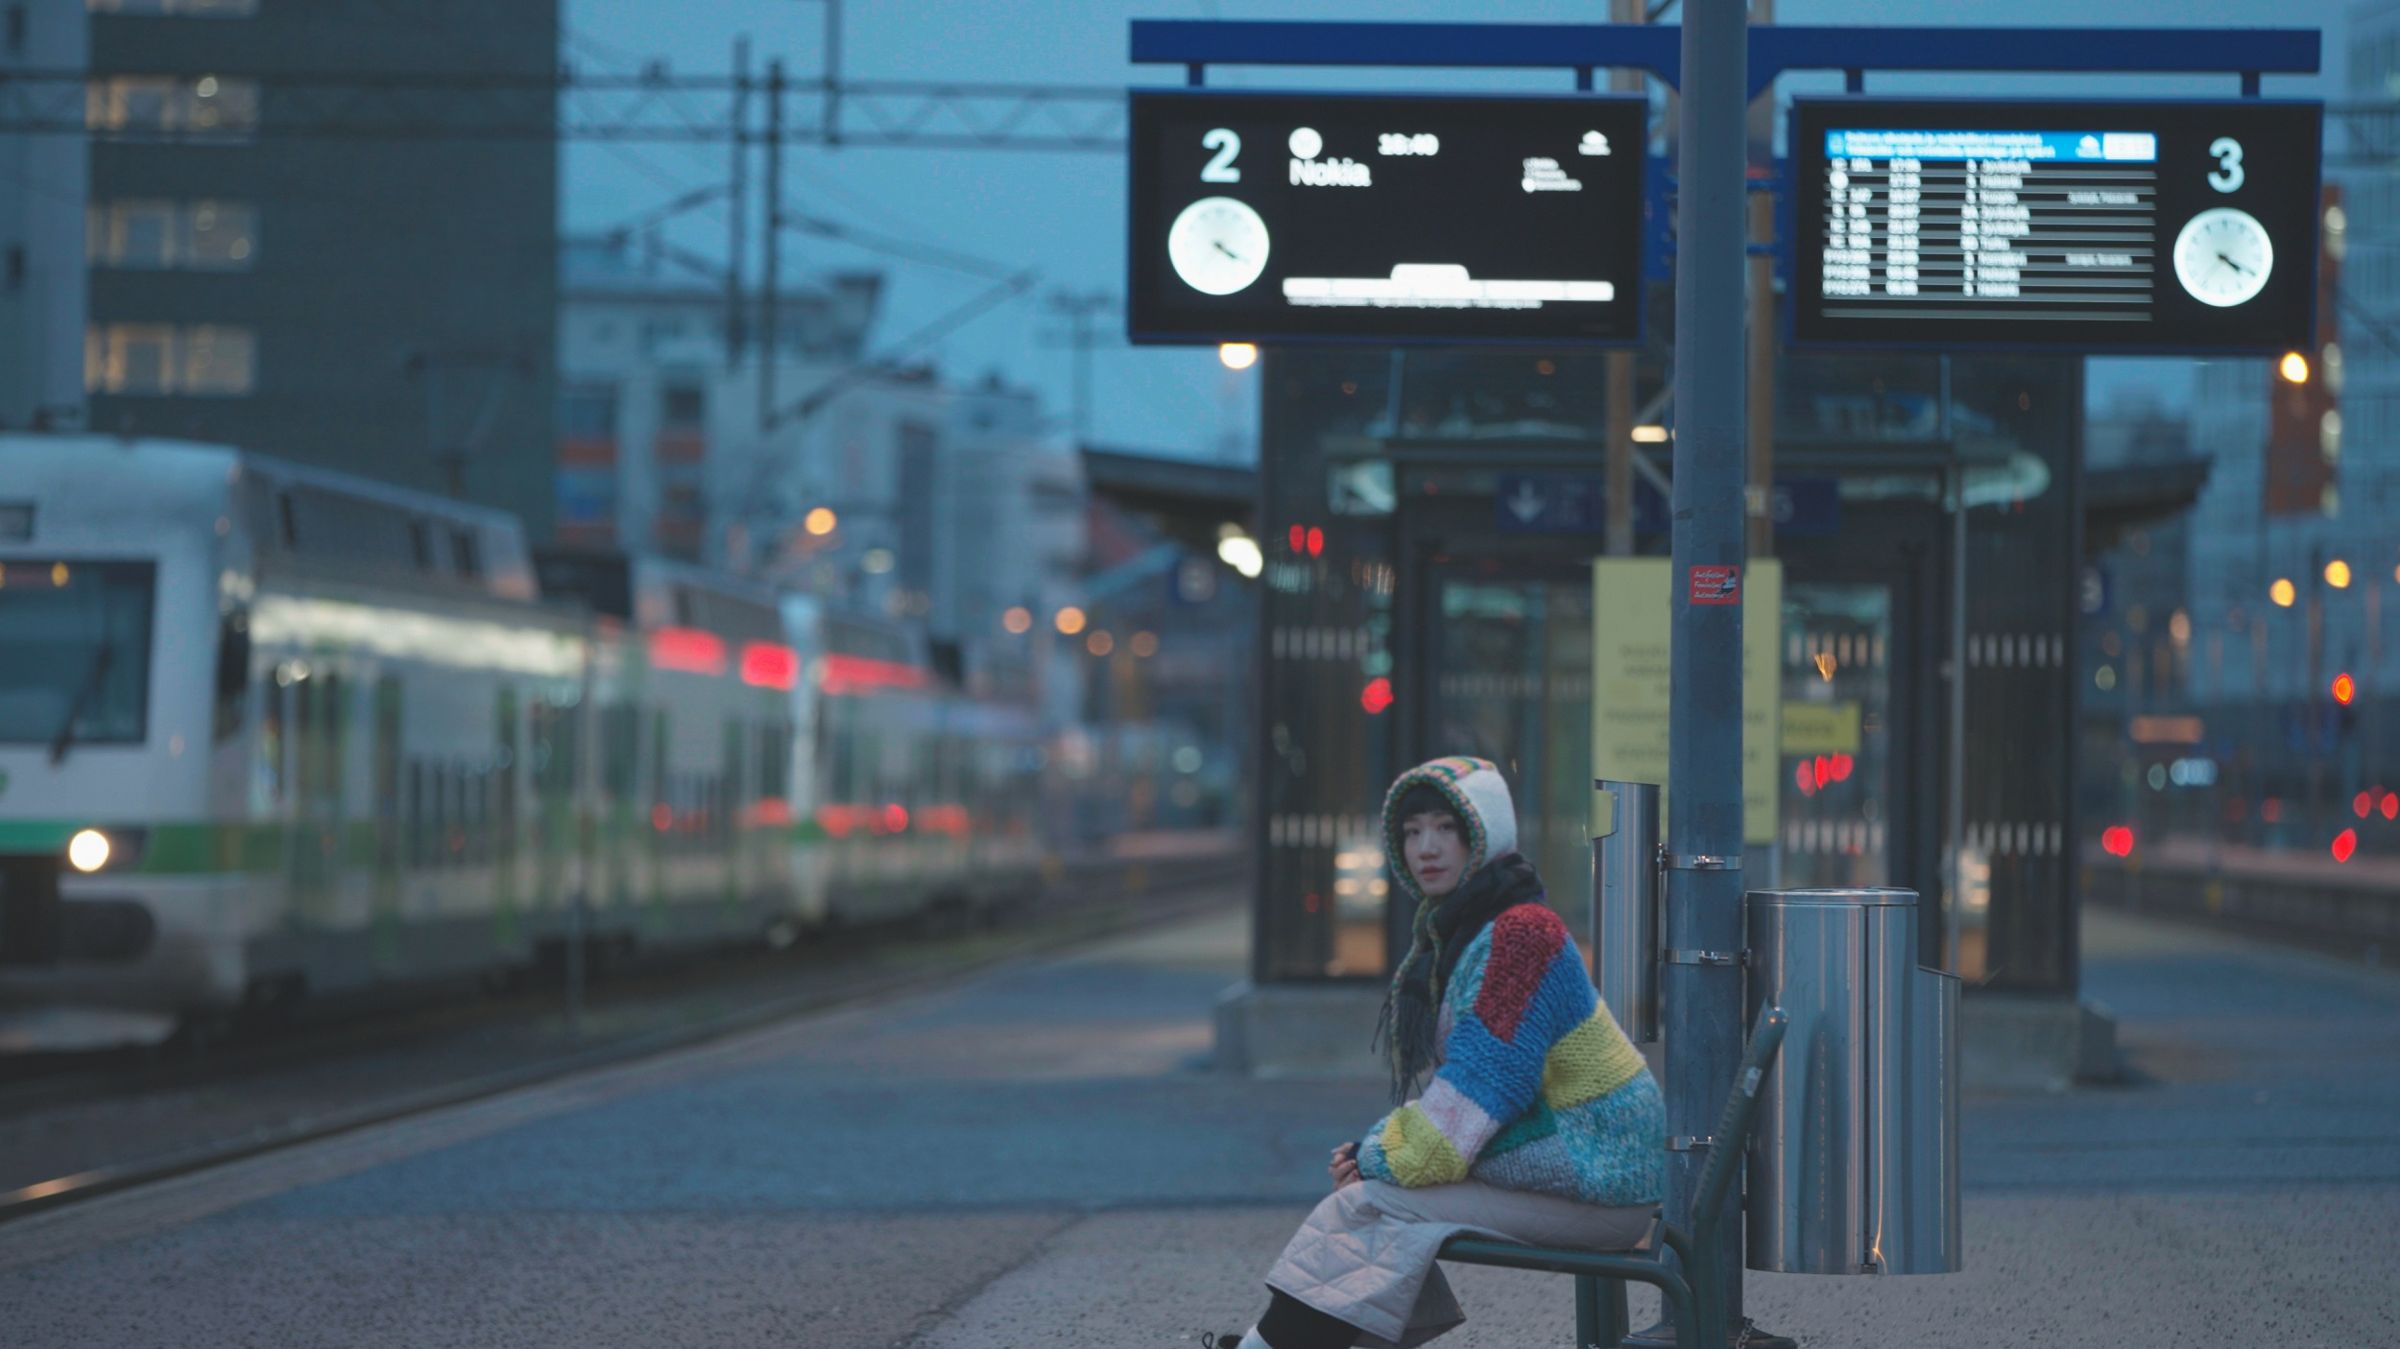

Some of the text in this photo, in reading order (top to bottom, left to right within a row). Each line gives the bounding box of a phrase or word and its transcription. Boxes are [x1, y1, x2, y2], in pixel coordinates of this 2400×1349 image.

[1201, 128, 1241, 183] 2
[1289, 157, 1373, 187] Nokia
[2208, 137, 2245, 193] 3
